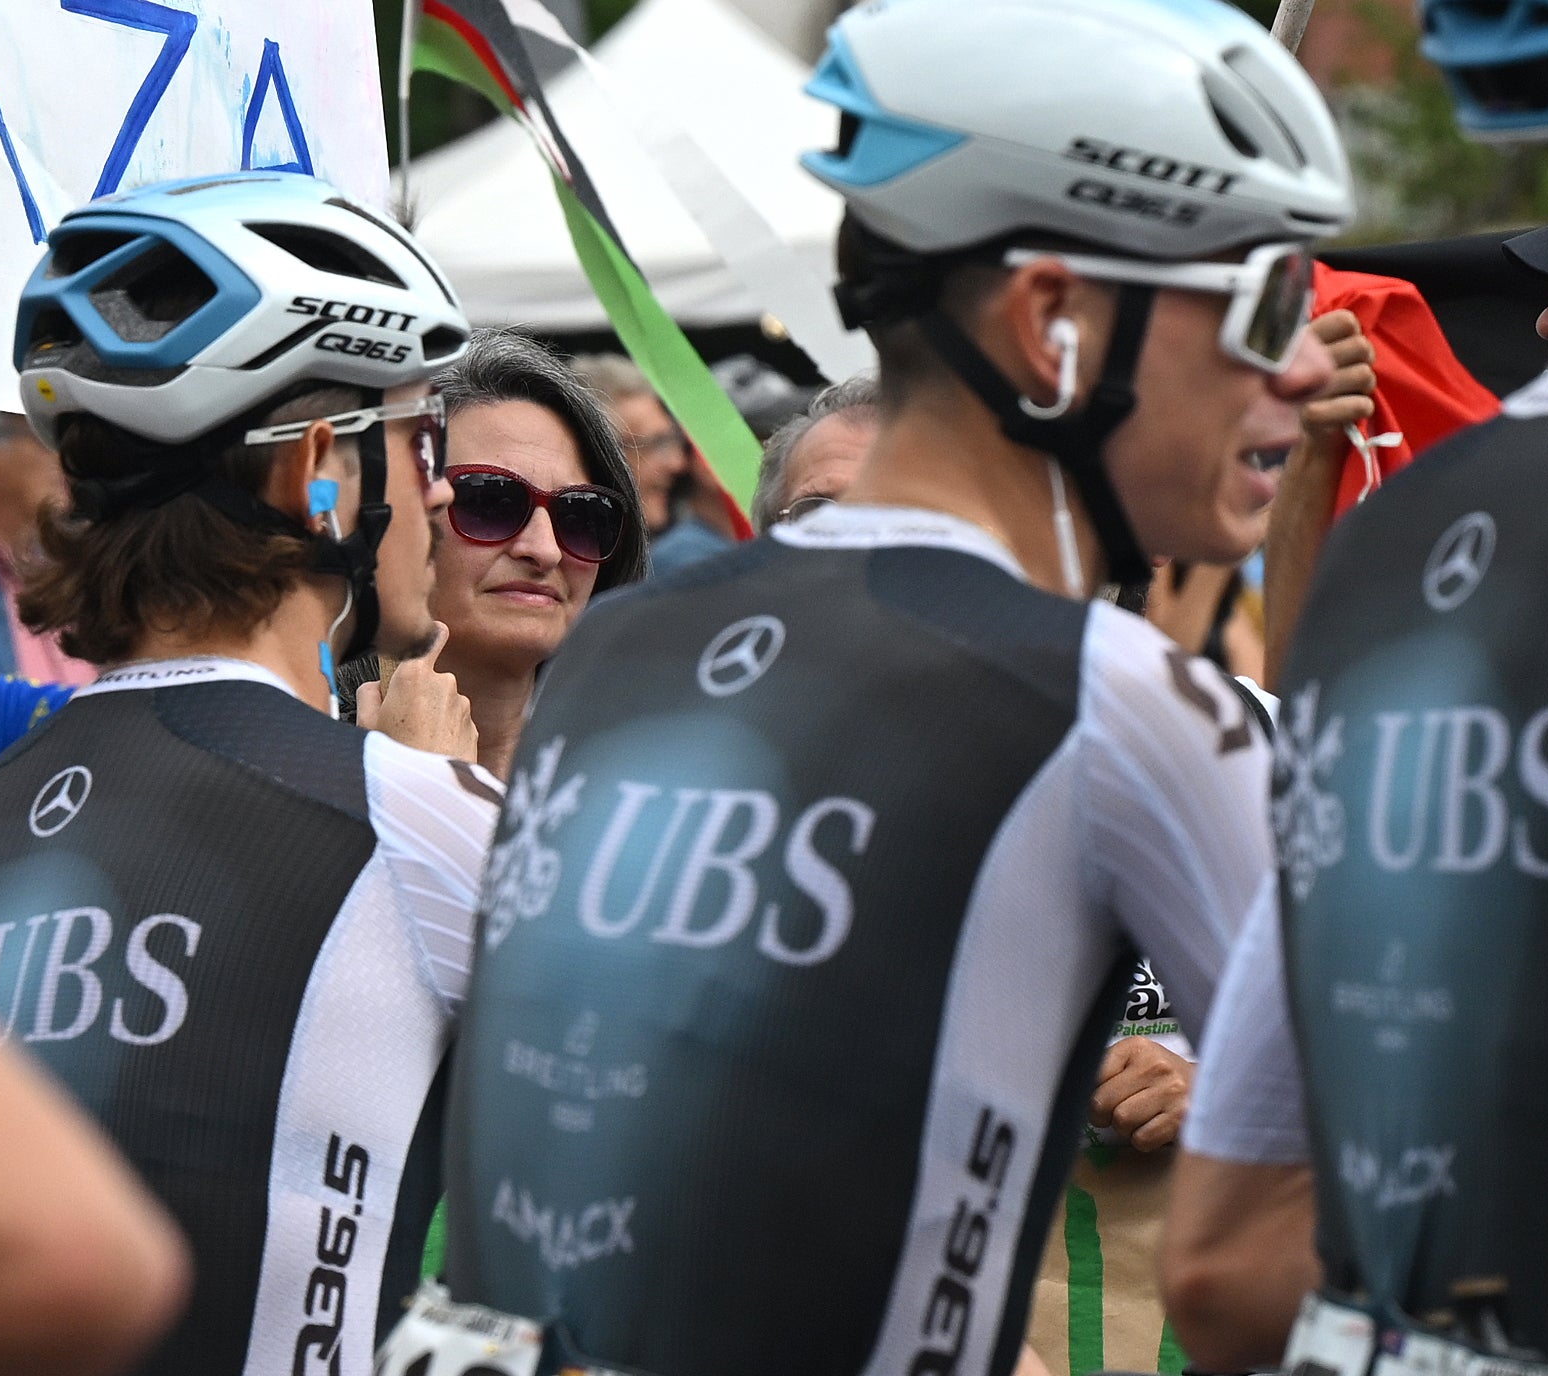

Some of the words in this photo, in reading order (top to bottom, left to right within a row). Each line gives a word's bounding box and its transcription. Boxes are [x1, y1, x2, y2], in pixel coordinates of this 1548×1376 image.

[1064, 137, 1240, 195] SCOTT
[285, 295, 419, 333] SCOTT
[313, 331, 414, 365] Q36.5
[577, 780, 877, 967] UBS
[1113, 1022, 1180, 1037] Palestina
